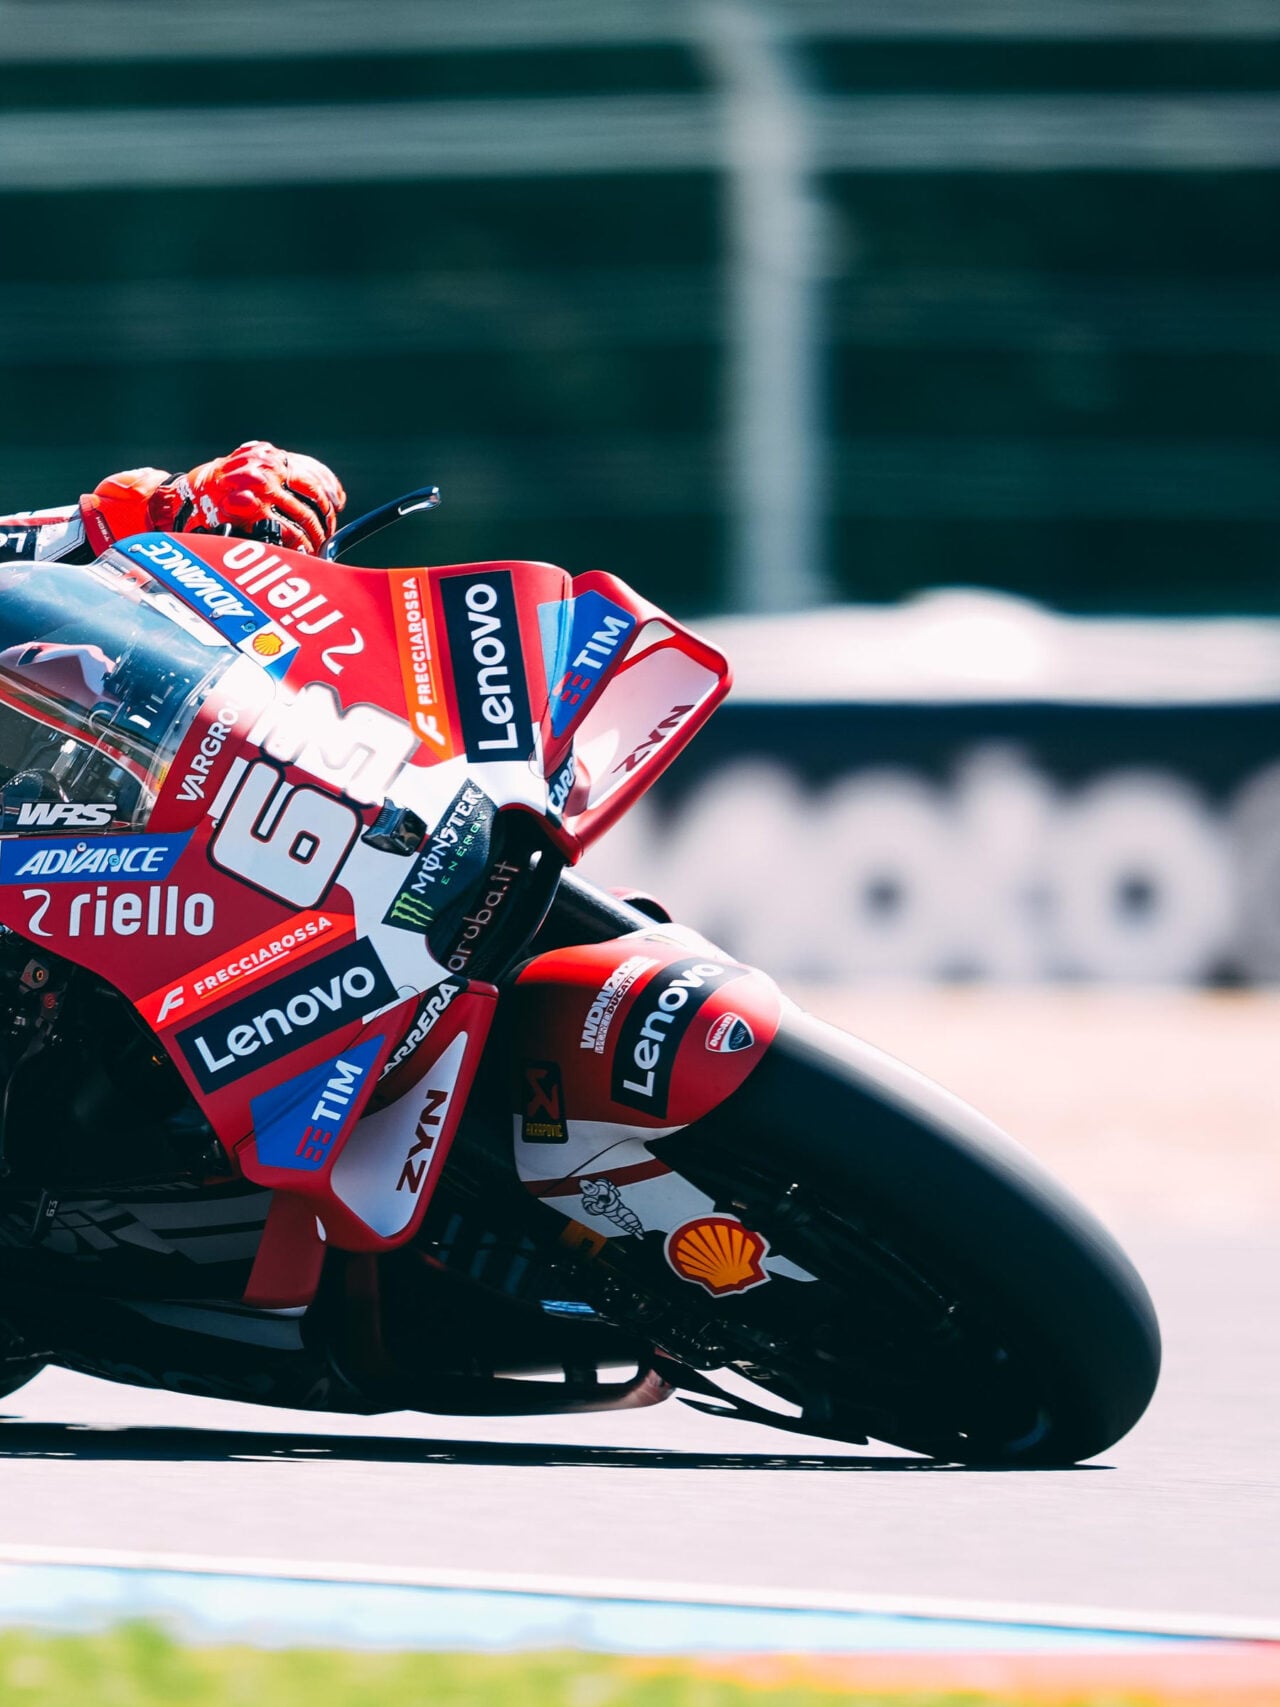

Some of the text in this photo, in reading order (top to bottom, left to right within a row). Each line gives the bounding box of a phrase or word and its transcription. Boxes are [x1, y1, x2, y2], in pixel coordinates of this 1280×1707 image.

[140, 541, 255, 618] ADVANCE
[222, 540, 344, 635] riello
[402, 577, 433, 706] FRECCIAROSSA
[465, 583, 518, 750] Lenovo
[572, 615, 630, 670] TIM
[611, 704, 696, 774] ZYN
[16, 802, 118, 826] WRS
[410, 787, 485, 895] MONSTER
[441, 810, 489, 886] ENERGY
[15, 846, 169, 876] ADVANCE
[68, 885, 215, 937] riello
[447, 860, 520, 972] aruba.it
[192, 916, 333, 997] FRECCIAROSSA
[193, 965, 376, 1074] Lenovo
[377, 982, 460, 1082] ARRERA
[622, 962, 726, 1098] Lenovo
[311, 1059, 364, 1121] TIM
[395, 1088, 449, 1194] ZYN
